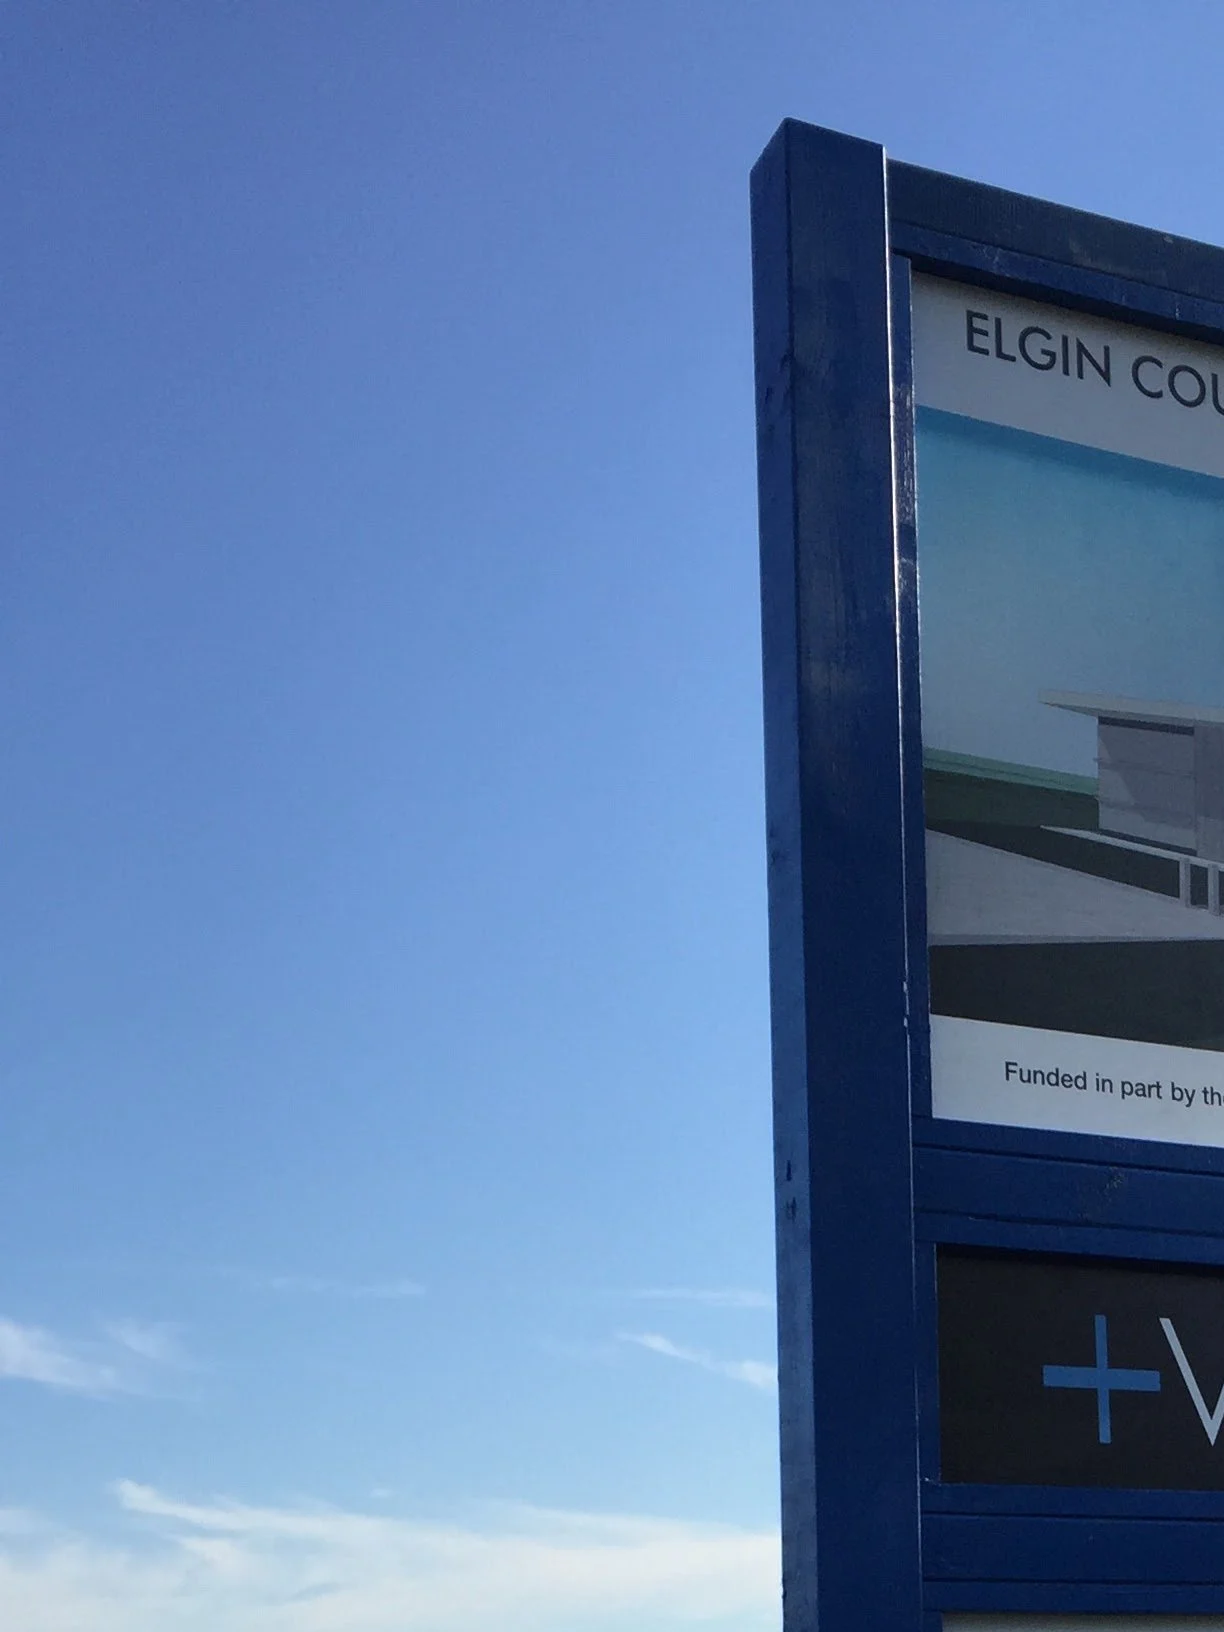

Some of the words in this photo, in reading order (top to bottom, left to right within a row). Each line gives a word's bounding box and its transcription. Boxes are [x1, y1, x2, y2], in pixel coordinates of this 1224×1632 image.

[965, 309, 1112, 388] ELGIN
[1004, 1061, 1088, 1093] Funded
[1095, 1070, 1115, 1094] in
[1119, 1078, 1163, 1104] part
[1170, 1081, 1196, 1107] by
